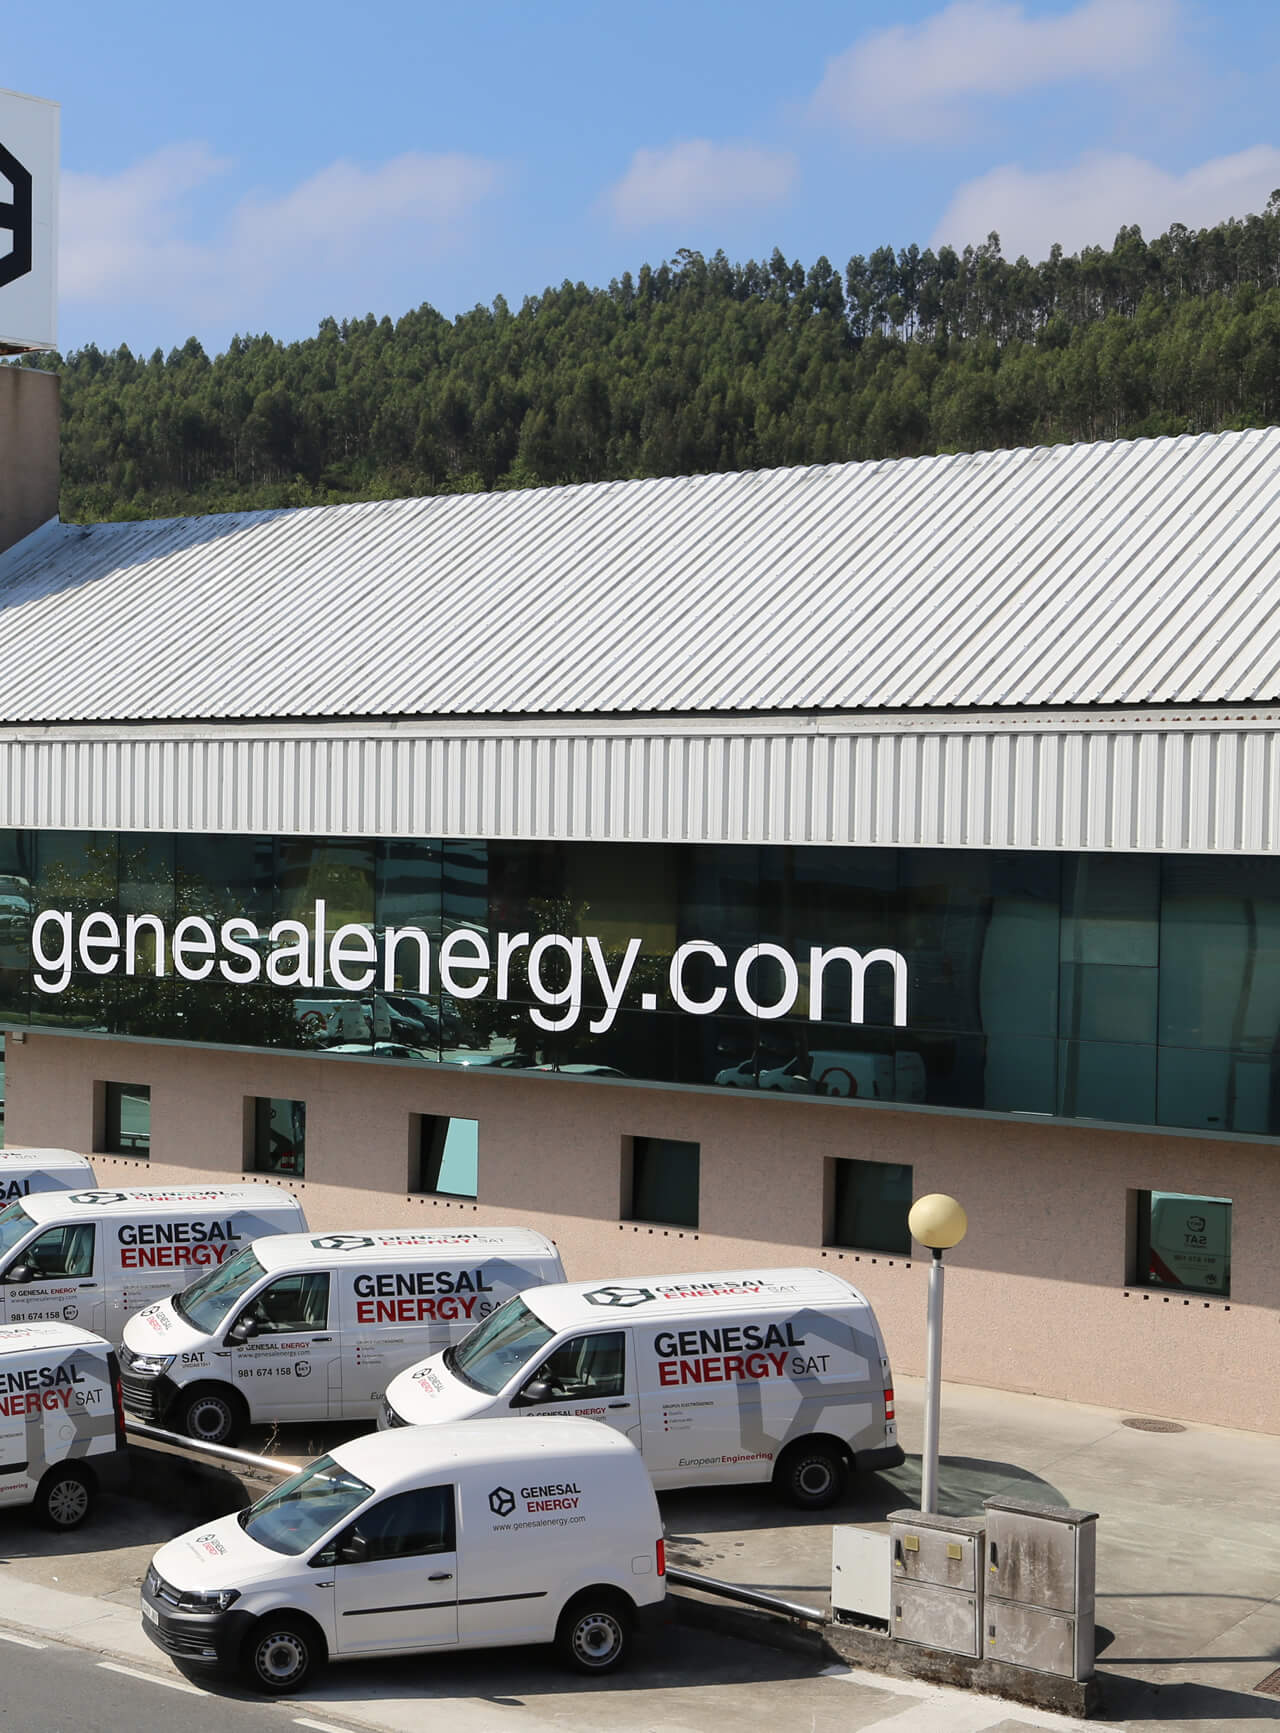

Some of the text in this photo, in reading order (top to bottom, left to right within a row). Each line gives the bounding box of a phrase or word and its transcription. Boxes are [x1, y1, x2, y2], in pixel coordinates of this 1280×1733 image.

[31, 899, 908, 1034] genesalenergy.com
[118, 1221, 241, 1245] GENESAL
[121, 1244, 228, 1268] ENERGY
[354, 1270, 493, 1297] GENESAL
[11, 1313, 25, 1321] 981
[28, 1312, 43, 1320] 674
[46, 1311, 60, 1319] 158
[357, 1296, 478, 1323] ENERGY
[654, 1323, 805, 1358] GENESAL
[182, 1352, 205, 1363] SAT
[238, 1367, 291, 1377] 981 674 158
[658, 1351, 830, 1386] ENERGY SAT
[75, 1388, 103, 1406] SAT
[575, 1407, 606, 1416] ENERGY
[520, 1483, 581, 1499] GENESAL
[527, 1498, 579, 1513] ENERGY
[492, 1515, 586, 1531] www.genesalenergy.com
